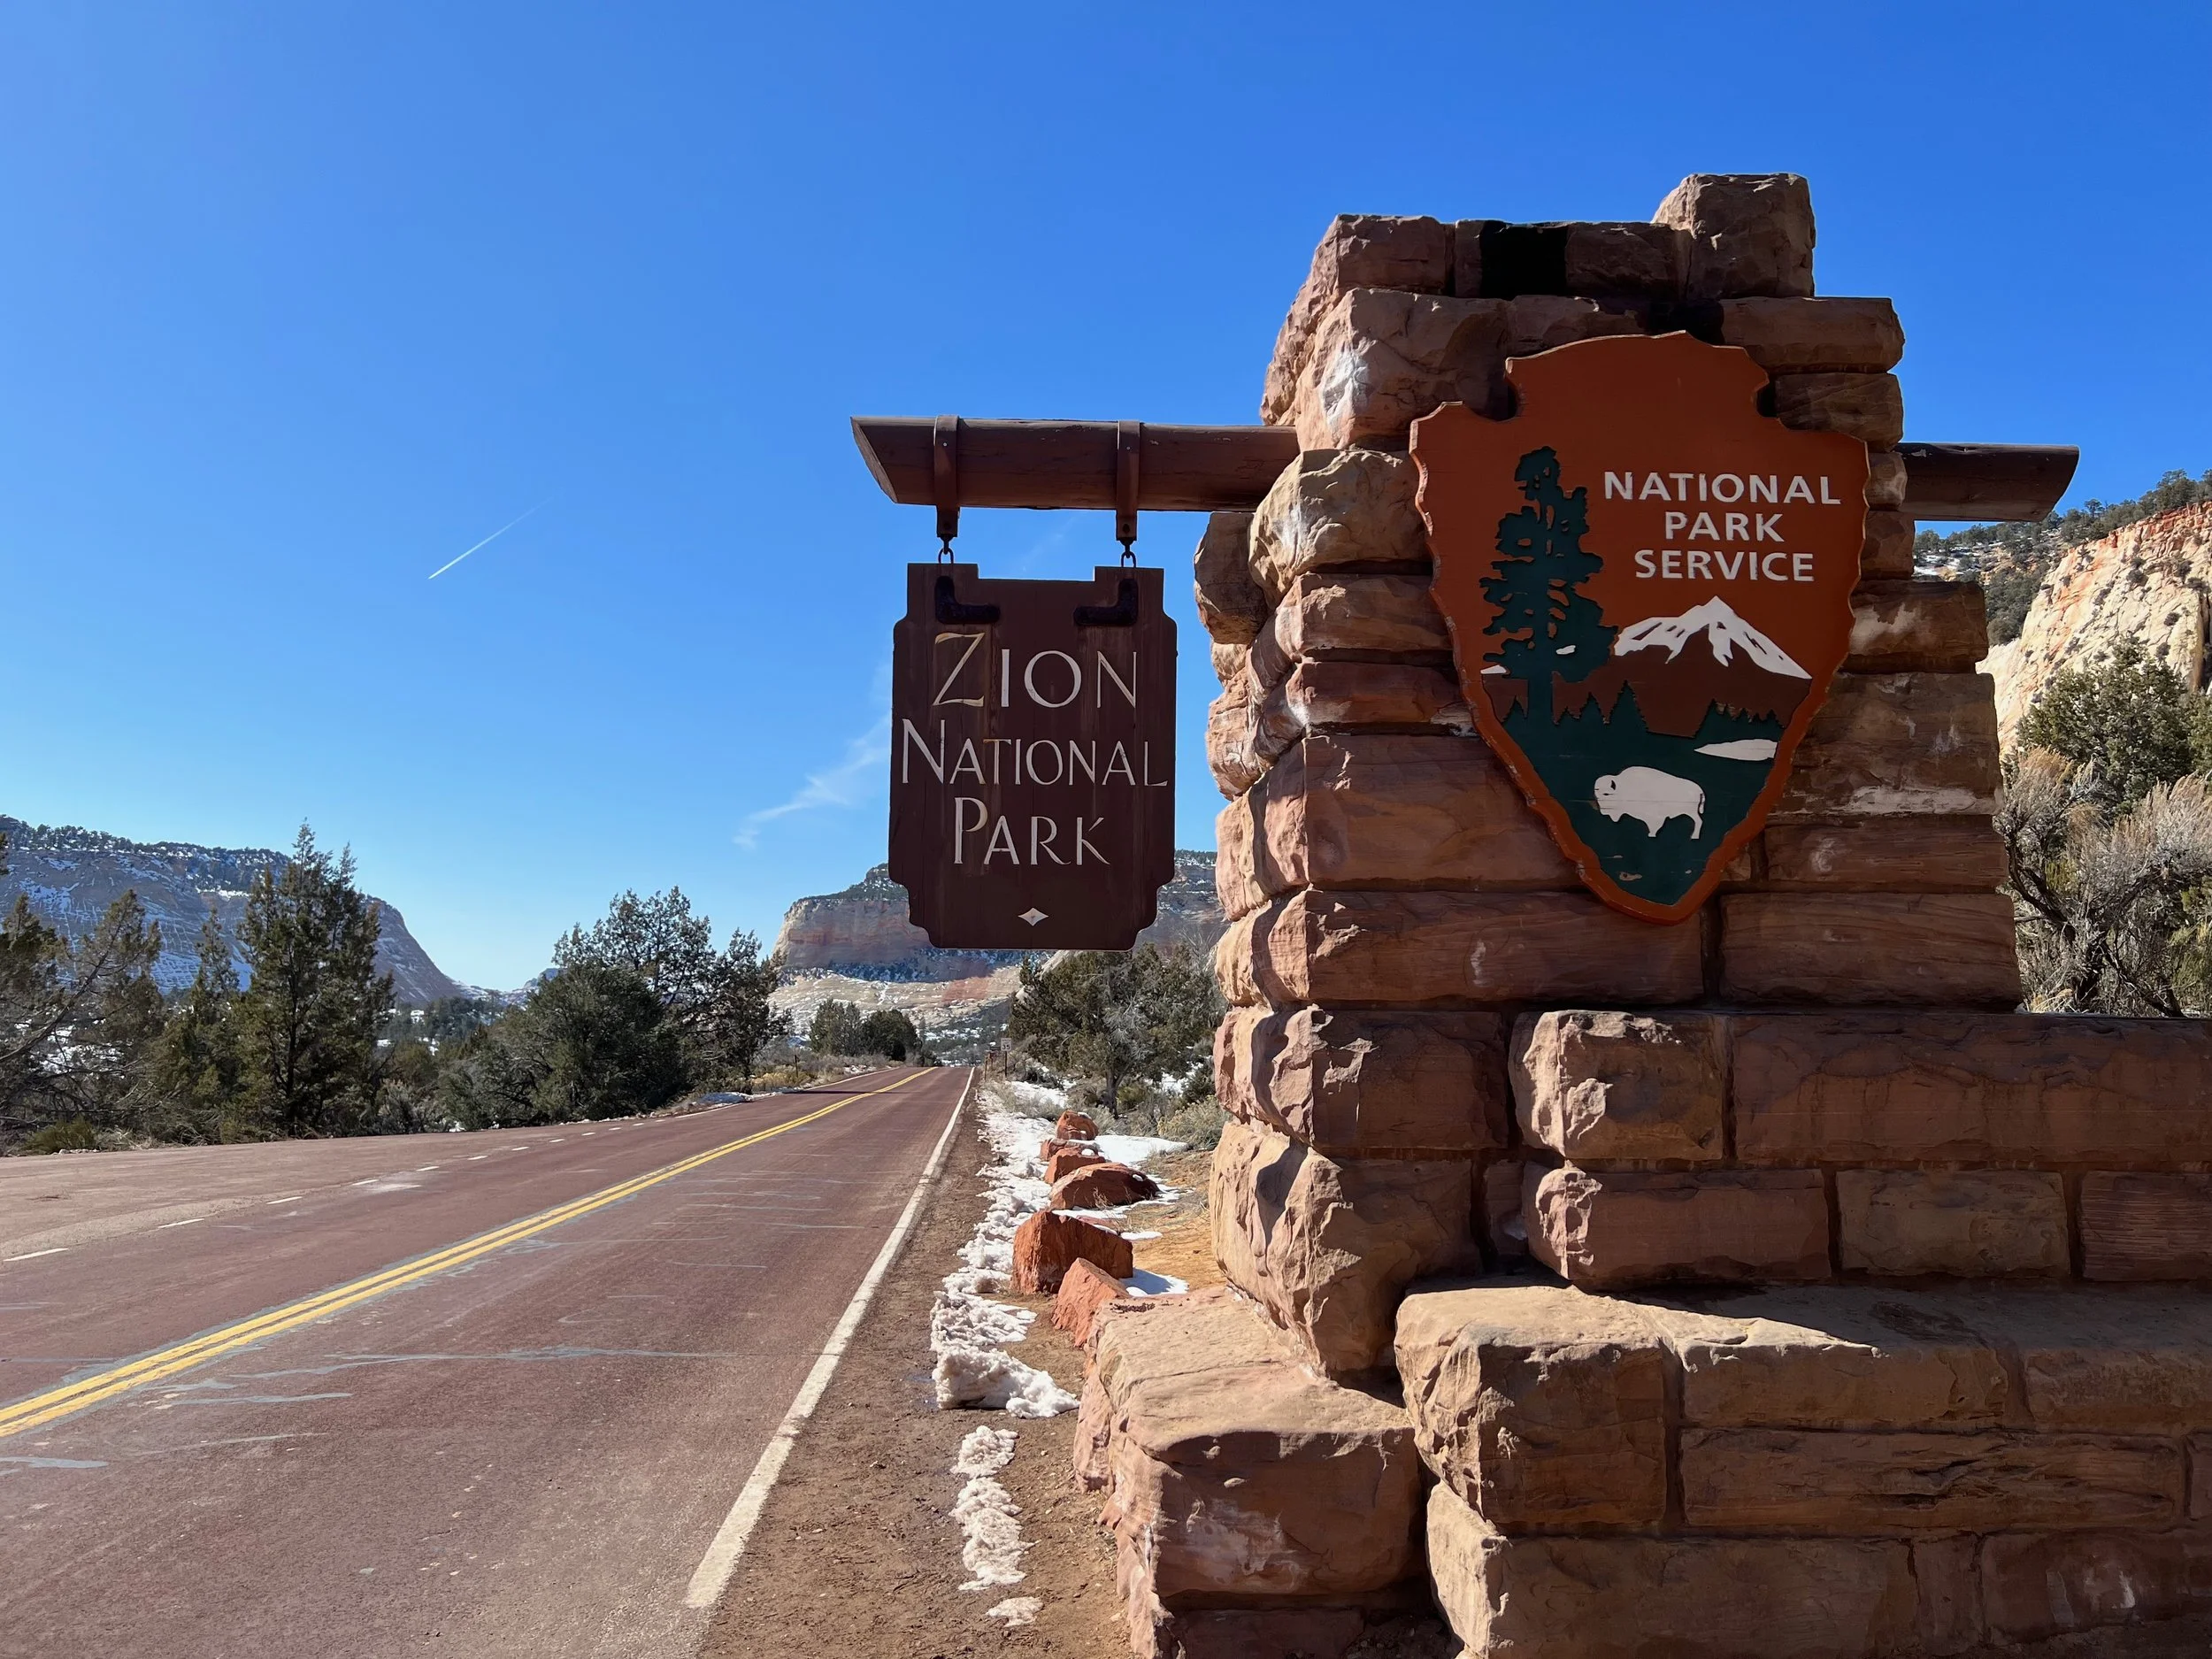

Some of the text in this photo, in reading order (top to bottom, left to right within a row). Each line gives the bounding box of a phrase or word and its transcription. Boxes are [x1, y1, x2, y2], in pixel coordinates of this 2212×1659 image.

[1604, 471, 1841, 504] NATIONAL
[1665, 511, 1785, 542] PARK
[1634, 549, 1814, 581] SERVICE
[932, 632, 1138, 708] ZION
[902, 718, 1168, 787] NATIONAL
[954, 797, 1110, 865] PARK
